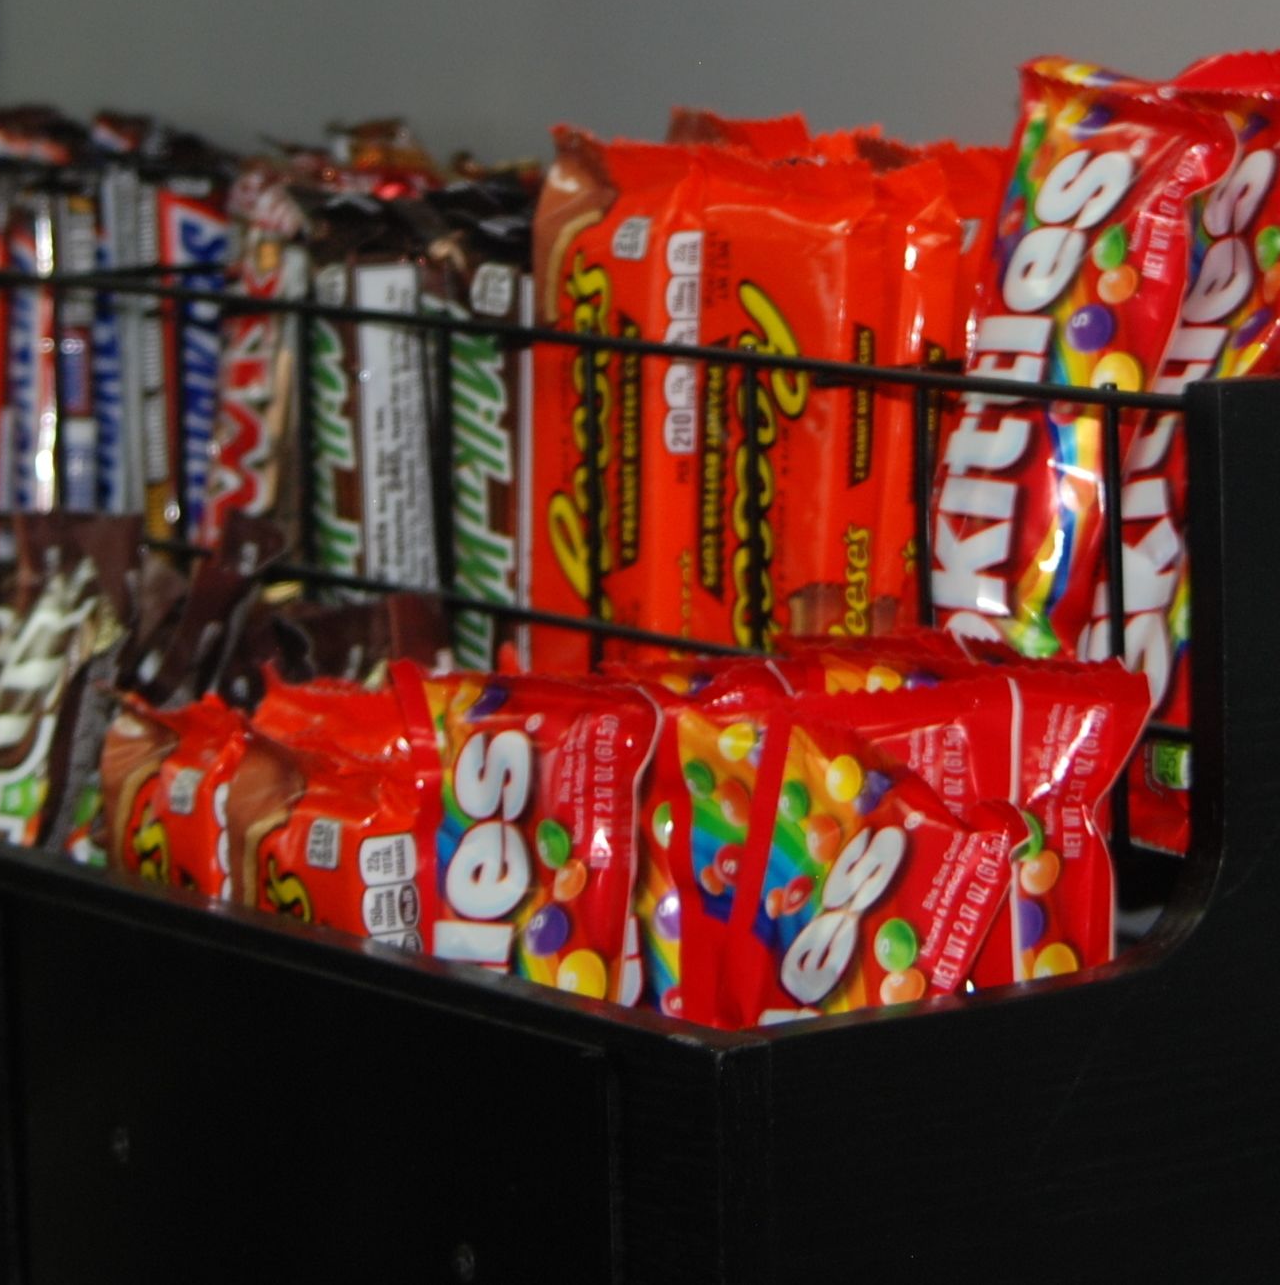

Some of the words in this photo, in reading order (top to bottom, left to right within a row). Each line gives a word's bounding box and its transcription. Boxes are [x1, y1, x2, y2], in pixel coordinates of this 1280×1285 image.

[858, 329, 871, 362] CUPS
[621, 383, 636, 458] BUTTER
[671, 414, 695, 449] 210
[856, 417, 868, 468] PEANUT
[621, 463, 637, 543] PEANUT
[703, 454, 719, 527] BUTTER
[702, 536, 719, 587] CUPS
[595, 713, 620, 763] (61.5g)
[1043, 703, 1062, 745] Candies
[560, 756, 574, 780] Size
[593, 765, 615, 783] OZ
[1073, 756, 1096, 776] OZ
[559, 781, 572, 804] Bite
[593, 787, 614, 813] 2.17
[943, 776, 963, 797] OZ
[1064, 778, 1087, 804] 2.17
[572, 807, 585, 846] Natural
[1061, 806, 1081, 828] WT
[382, 845, 393, 875] TOTAL
[1062, 831, 1081, 859] NET
[367, 850, 380, 873] 22g
[921, 888, 941, 911] Bite
[931, 862, 952, 888] Size
[938, 863, 968, 908] Artificial
[964, 880, 991, 906] OZ
[935, 906, 949, 918] &
[952, 902, 981, 936] 2.17
[920, 916, 945, 957] Natural
[942, 933, 968, 961] WT
[930, 958, 959, 990] NET
